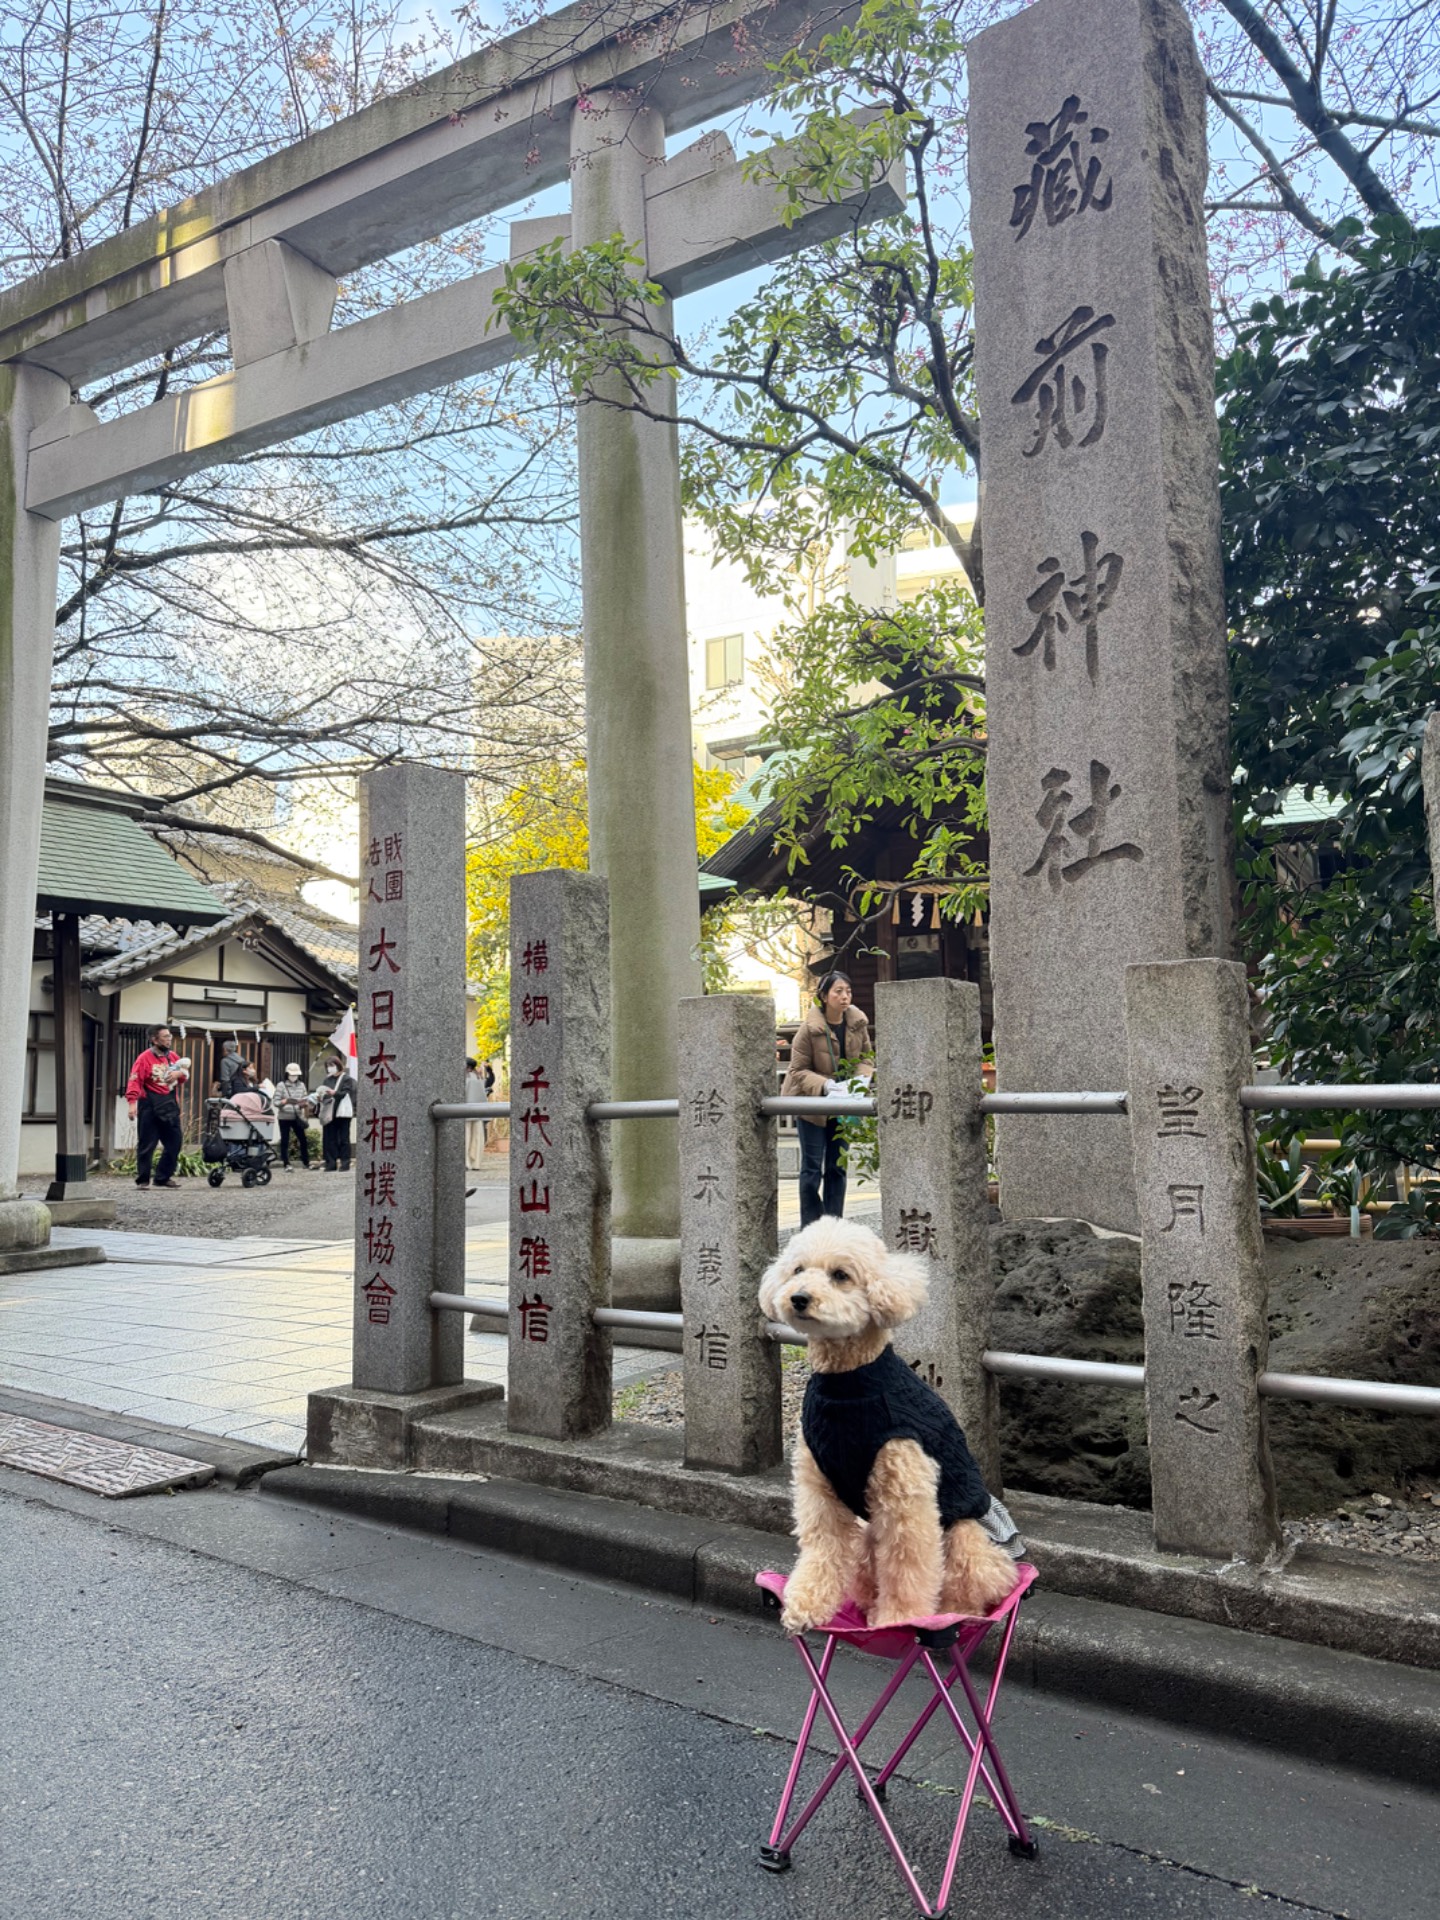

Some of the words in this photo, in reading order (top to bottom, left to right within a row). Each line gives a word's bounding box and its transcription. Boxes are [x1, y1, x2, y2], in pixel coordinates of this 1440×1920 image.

[689, 1088, 731, 1370] 鈴木義信
[1156, 1083, 1222, 1434] 望月隆之
